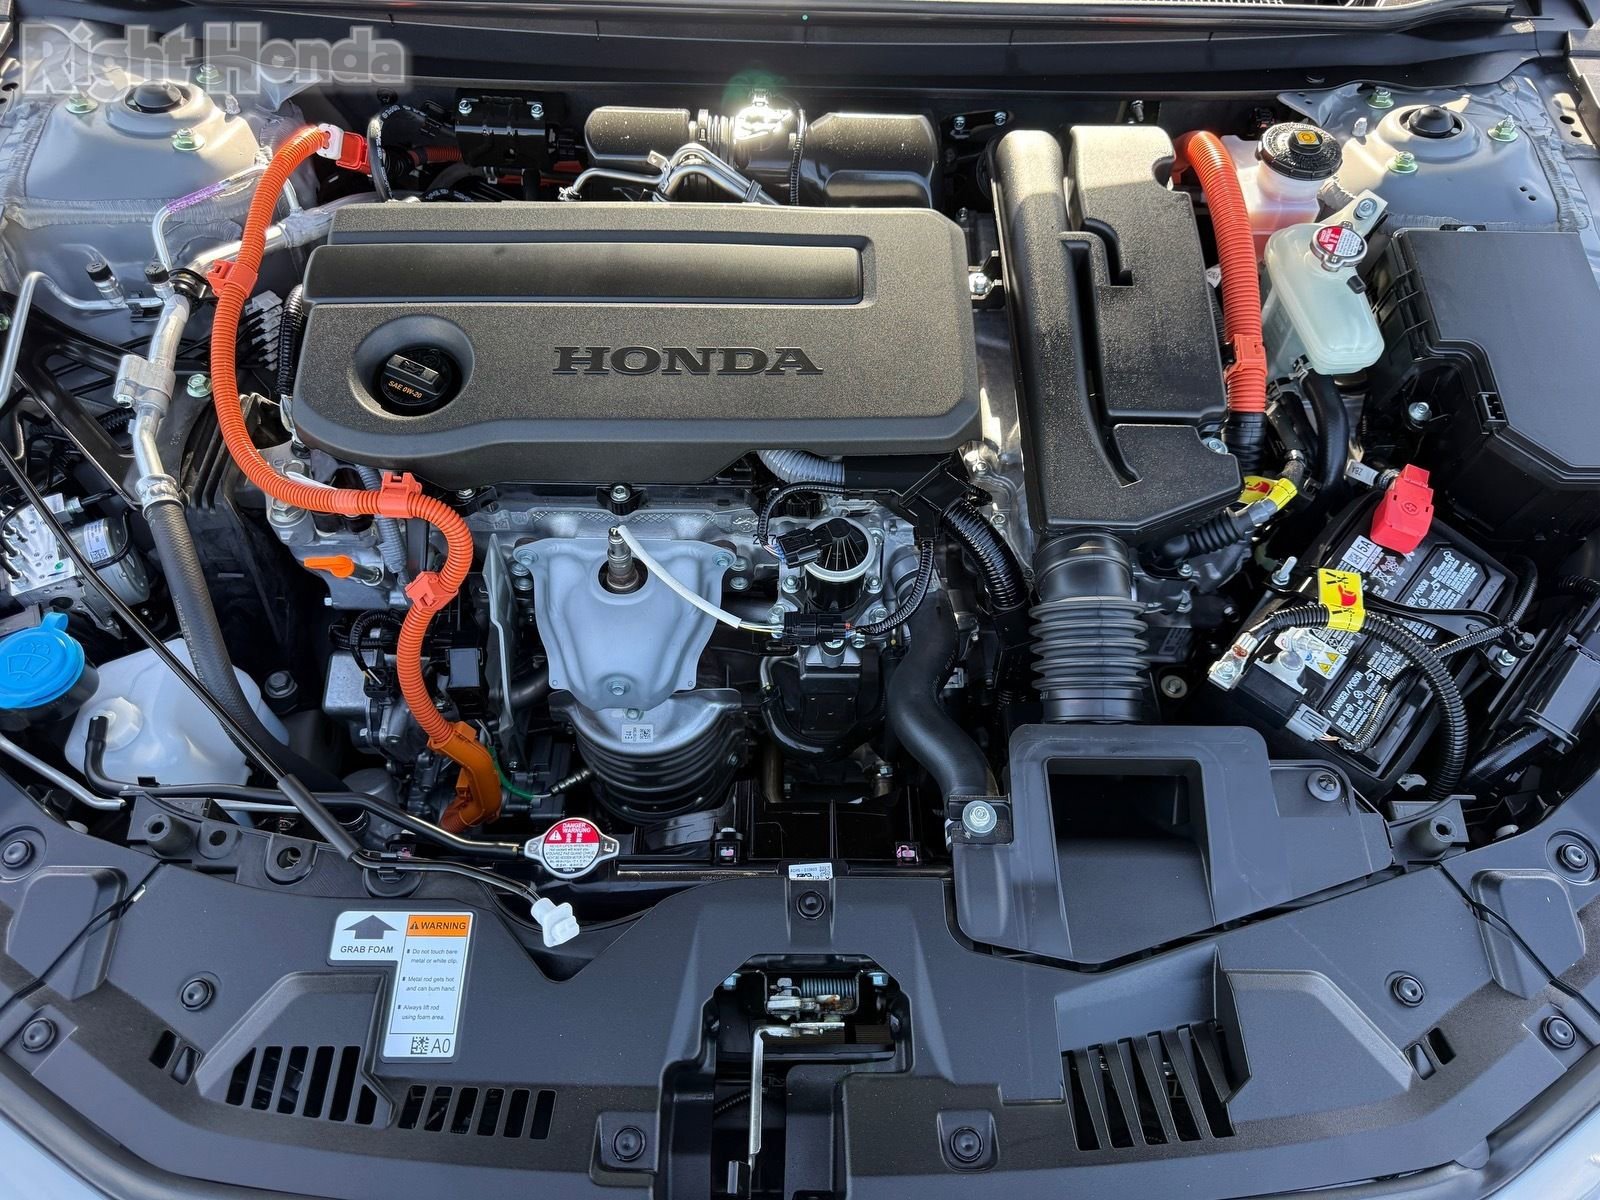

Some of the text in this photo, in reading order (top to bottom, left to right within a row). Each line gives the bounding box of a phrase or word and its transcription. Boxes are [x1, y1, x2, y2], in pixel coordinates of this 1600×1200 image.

[551, 345, 823, 375] HONDA
[388, 380, 422, 399] SAE 0W-20
[1356, 540, 1372, 552] 5A
[421, 921, 466, 930] WARNING
[340, 945, 394, 954] GRAB FOAM
[431, 1038, 451, 1054] A0
